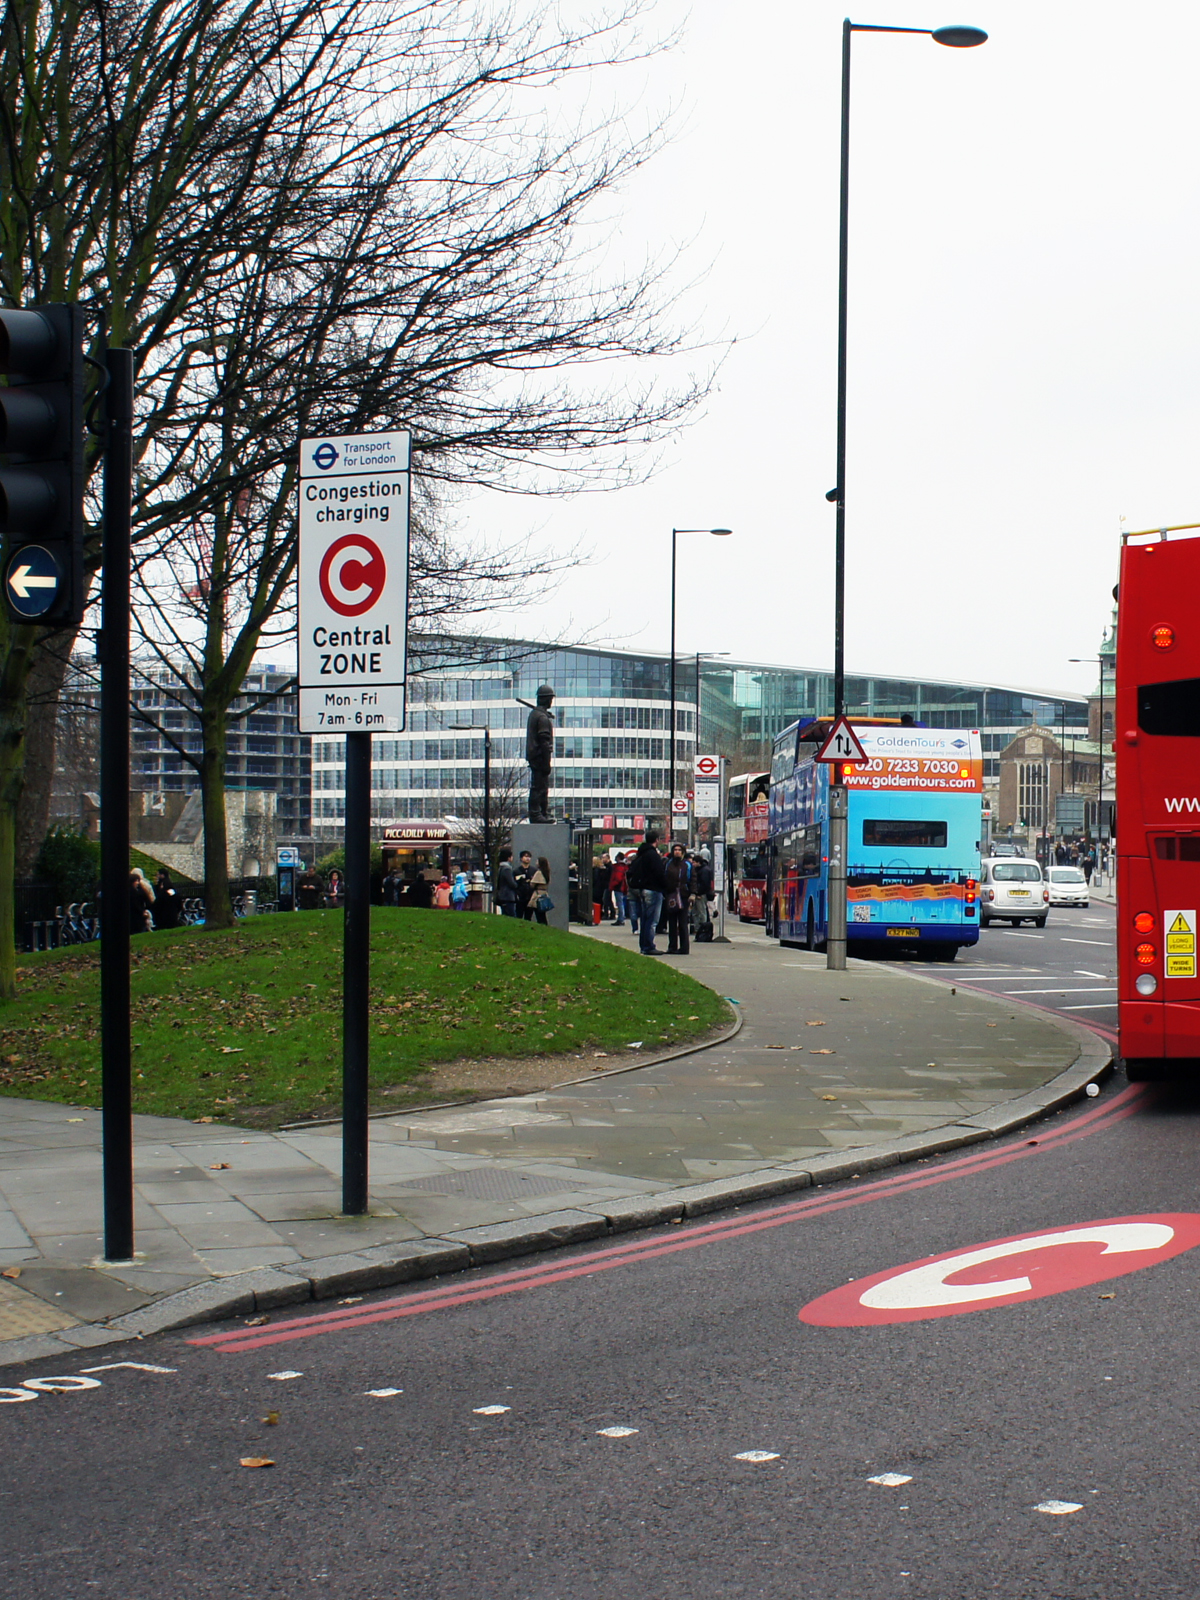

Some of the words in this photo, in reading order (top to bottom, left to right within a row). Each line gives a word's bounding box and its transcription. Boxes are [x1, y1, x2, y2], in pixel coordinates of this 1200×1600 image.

[344, 441, 391, 454] Transport
[343, 456, 359, 467] for
[360, 453, 396, 466] London
[306, 481, 402, 502] Congestion
[316, 504, 390, 523] charging
[313, 625, 392, 648] Central
[320, 653, 382, 675] ZONE
[325, 693, 351, 706] Mon
[361, 692, 378, 705] Fri
[886, 759, 919, 773] 7233
[922, 760, 959, 774] 7030
[842, 774, 976, 789] www.goldentours.com
[385, 828, 425, 838] PICCADILLY
[426, 828, 447, 838] WHIP
